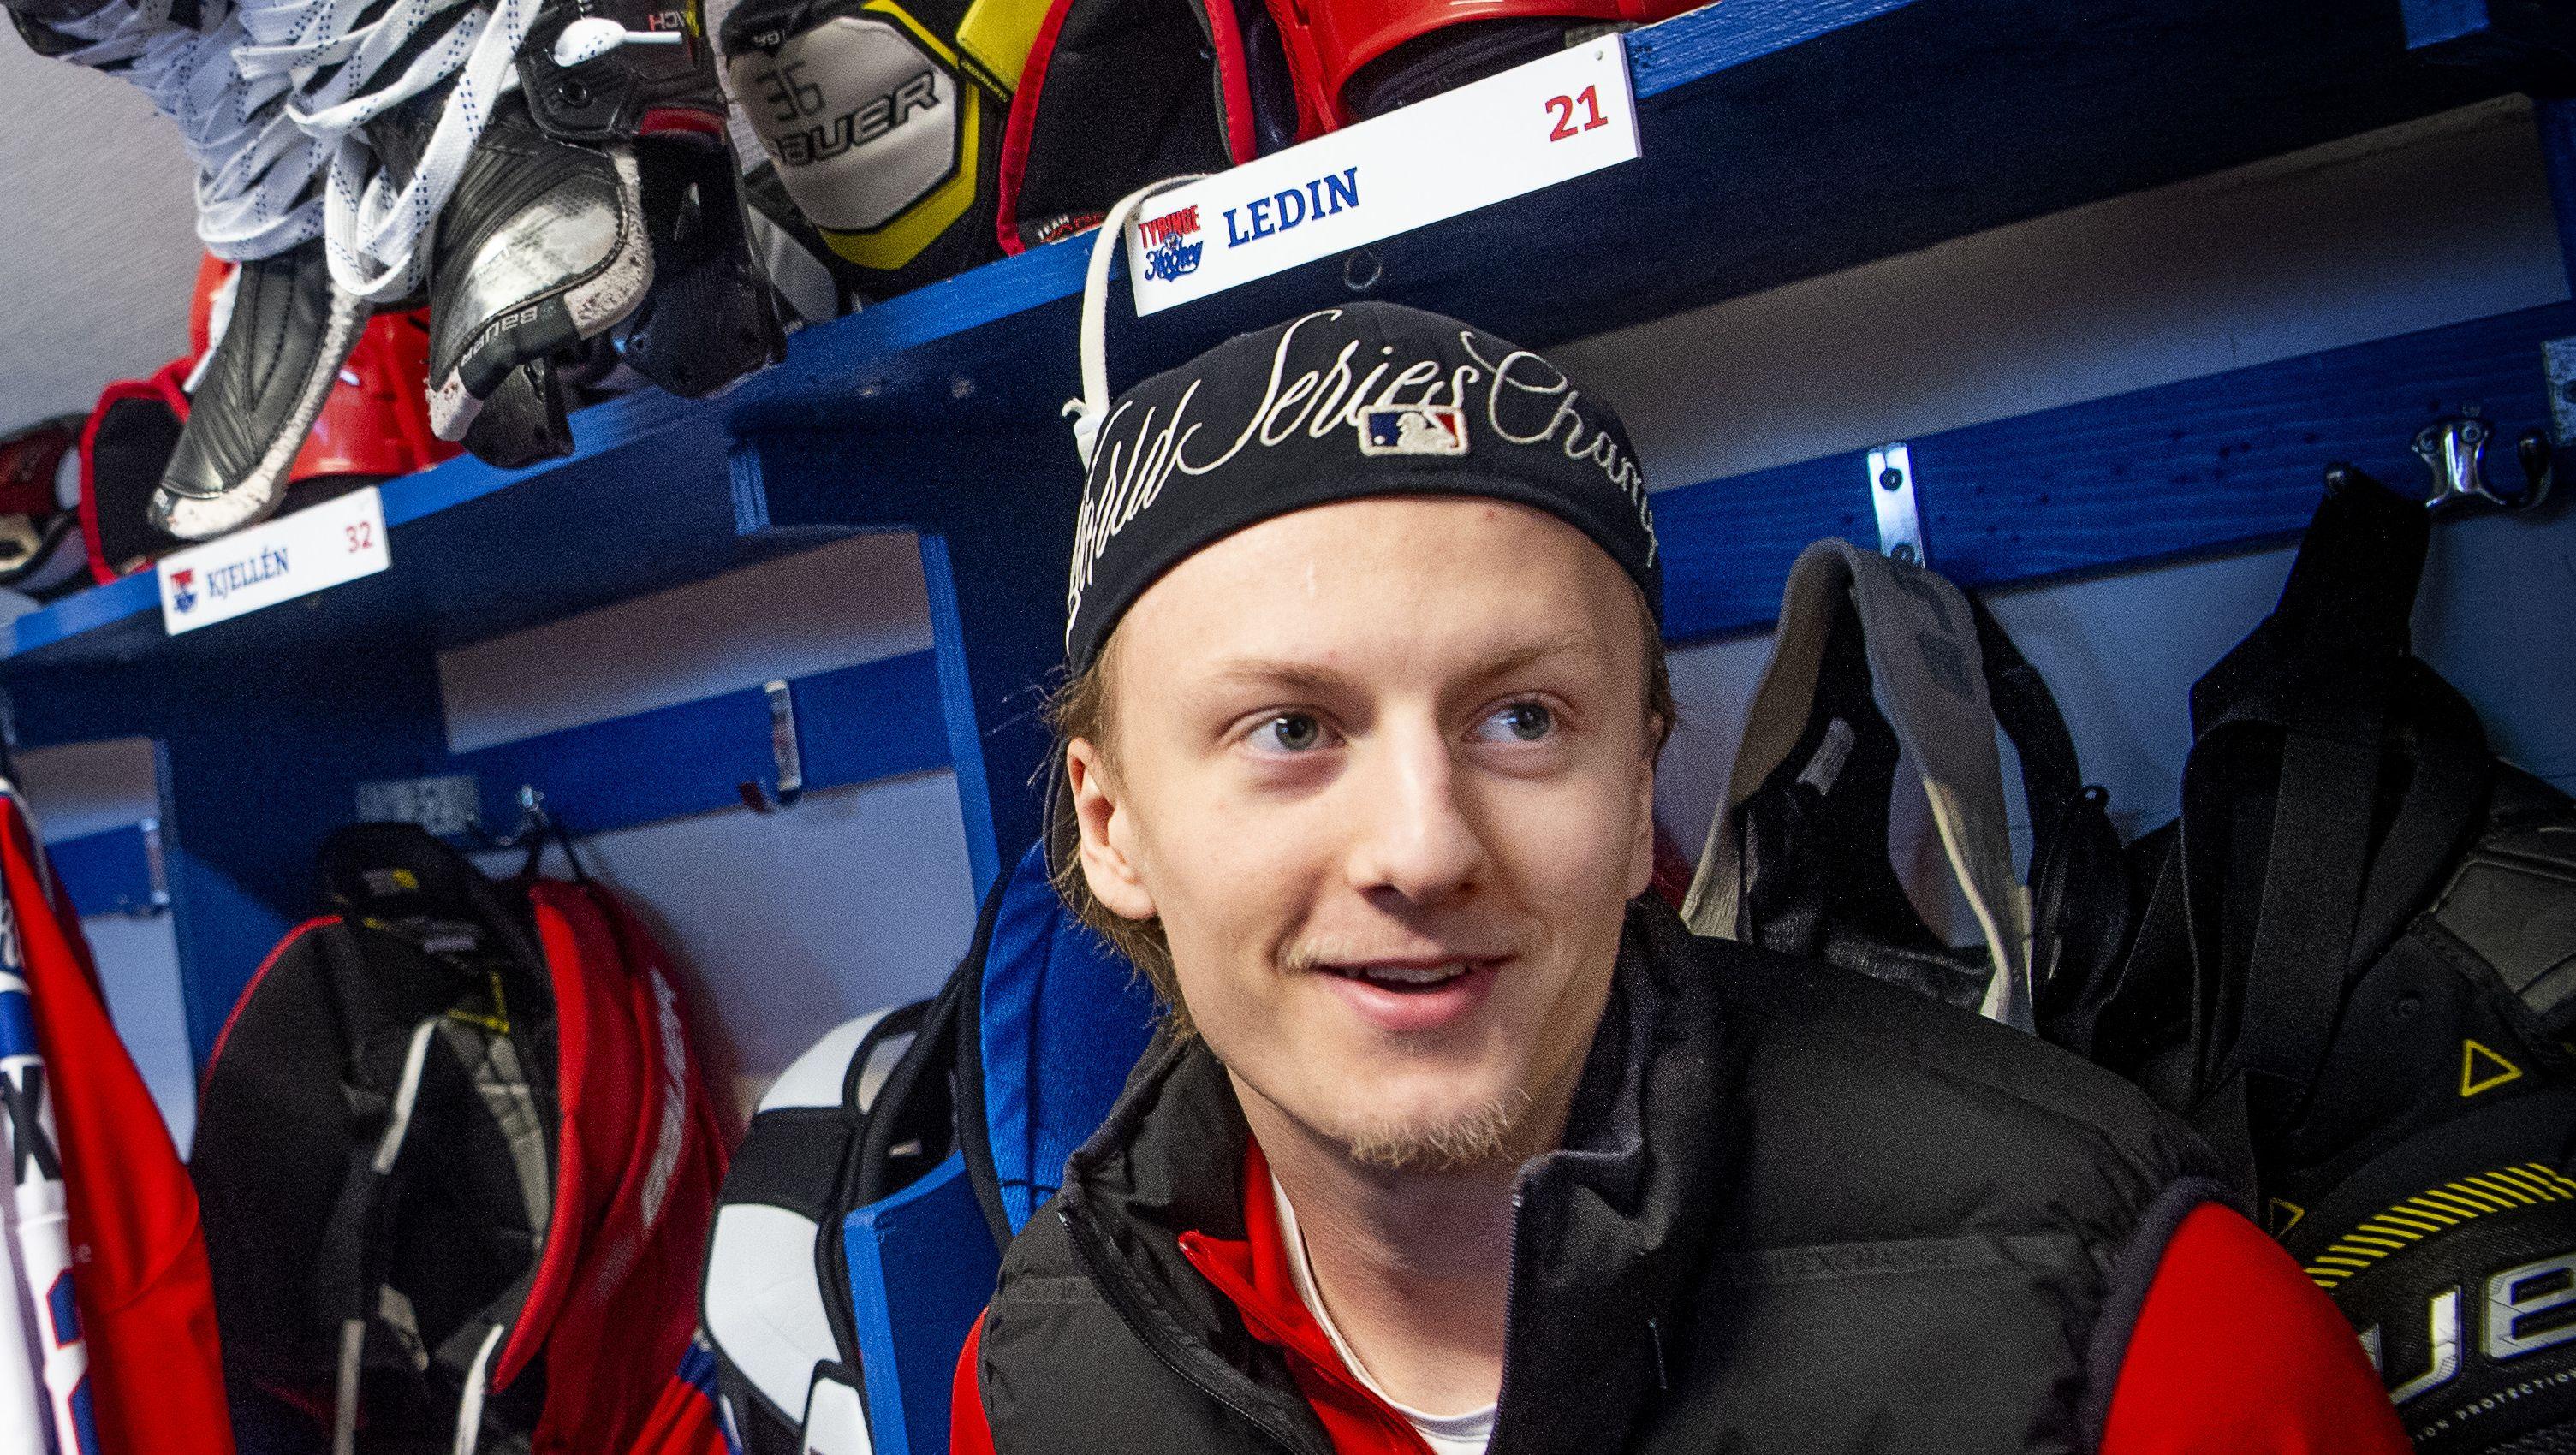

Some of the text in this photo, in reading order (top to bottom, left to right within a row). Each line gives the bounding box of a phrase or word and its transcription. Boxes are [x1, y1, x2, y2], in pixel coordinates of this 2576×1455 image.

[774, 70, 940, 167] AUER
[1544, 84, 1608, 142] 21
[1139, 205, 1201, 249] TYRINGE
[1223, 166, 1359, 249] LEDIN
[1177, 309, 1480, 475] Series
[346, 521, 372, 554] 32
[206, 546, 289, 599] KJELLÉN
